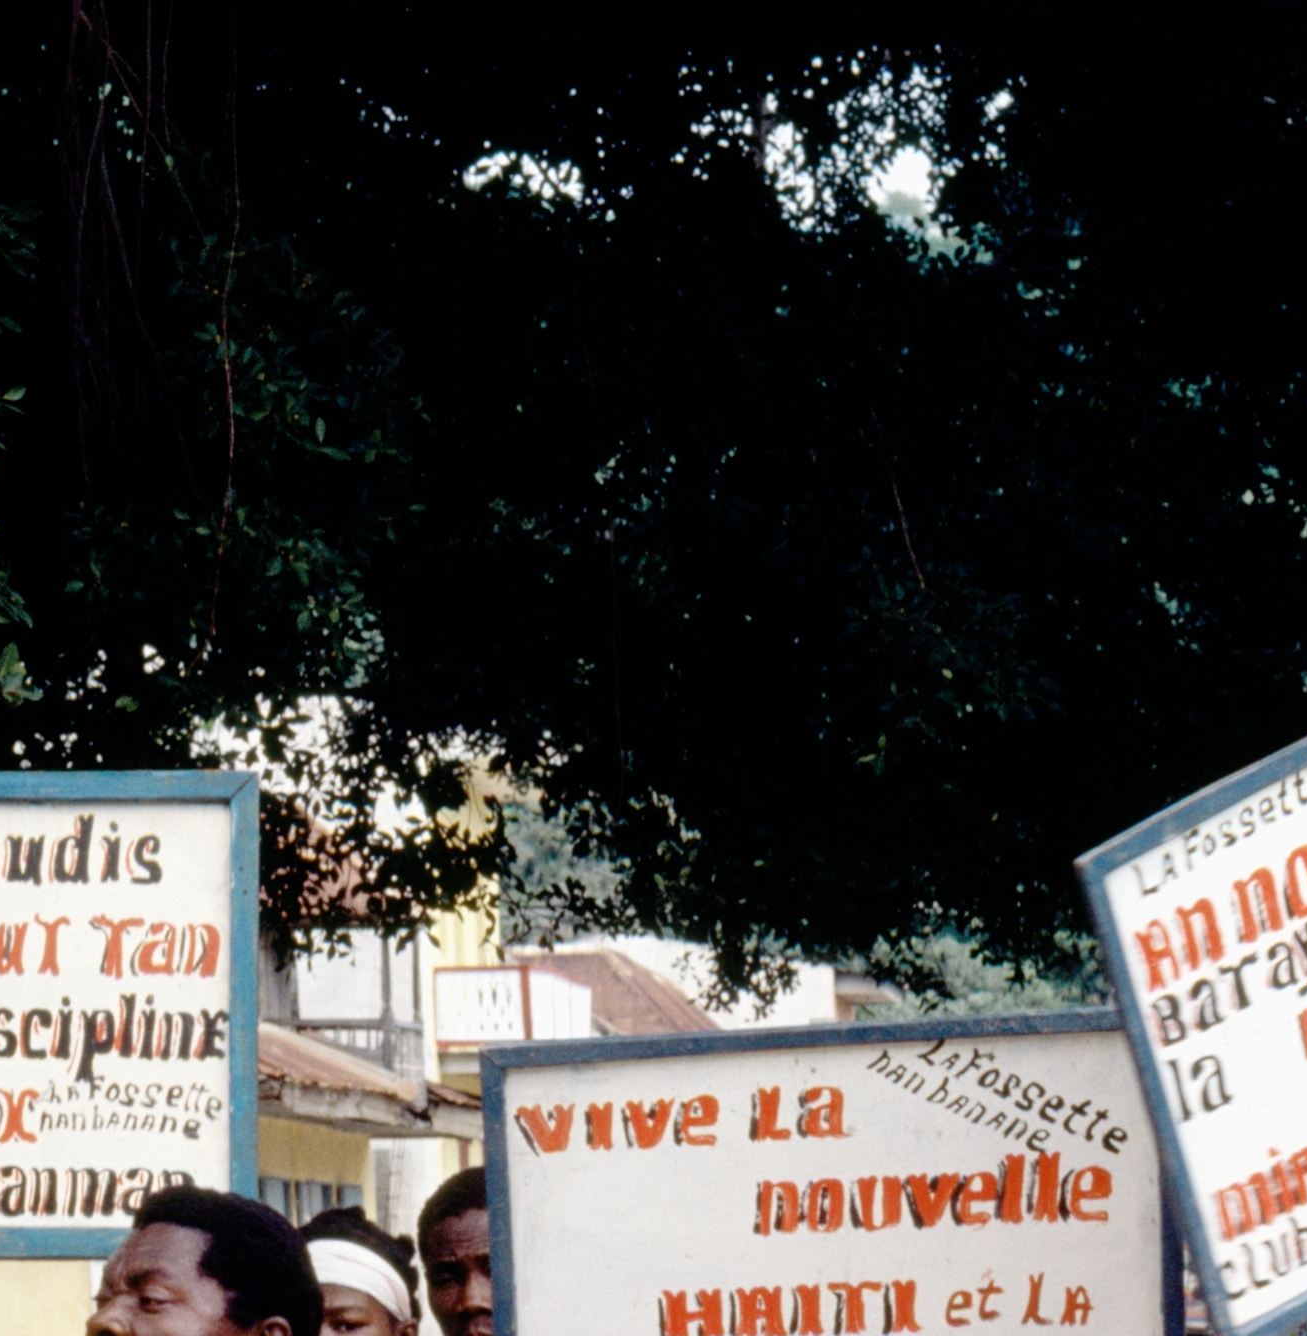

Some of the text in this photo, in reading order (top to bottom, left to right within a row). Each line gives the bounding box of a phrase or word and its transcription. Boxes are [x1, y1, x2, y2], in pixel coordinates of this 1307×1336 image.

[1167, 1055, 1233, 1122] la
[753, 1151, 1113, 1236] nouvelle
[945, 1271, 1004, 1327] et
